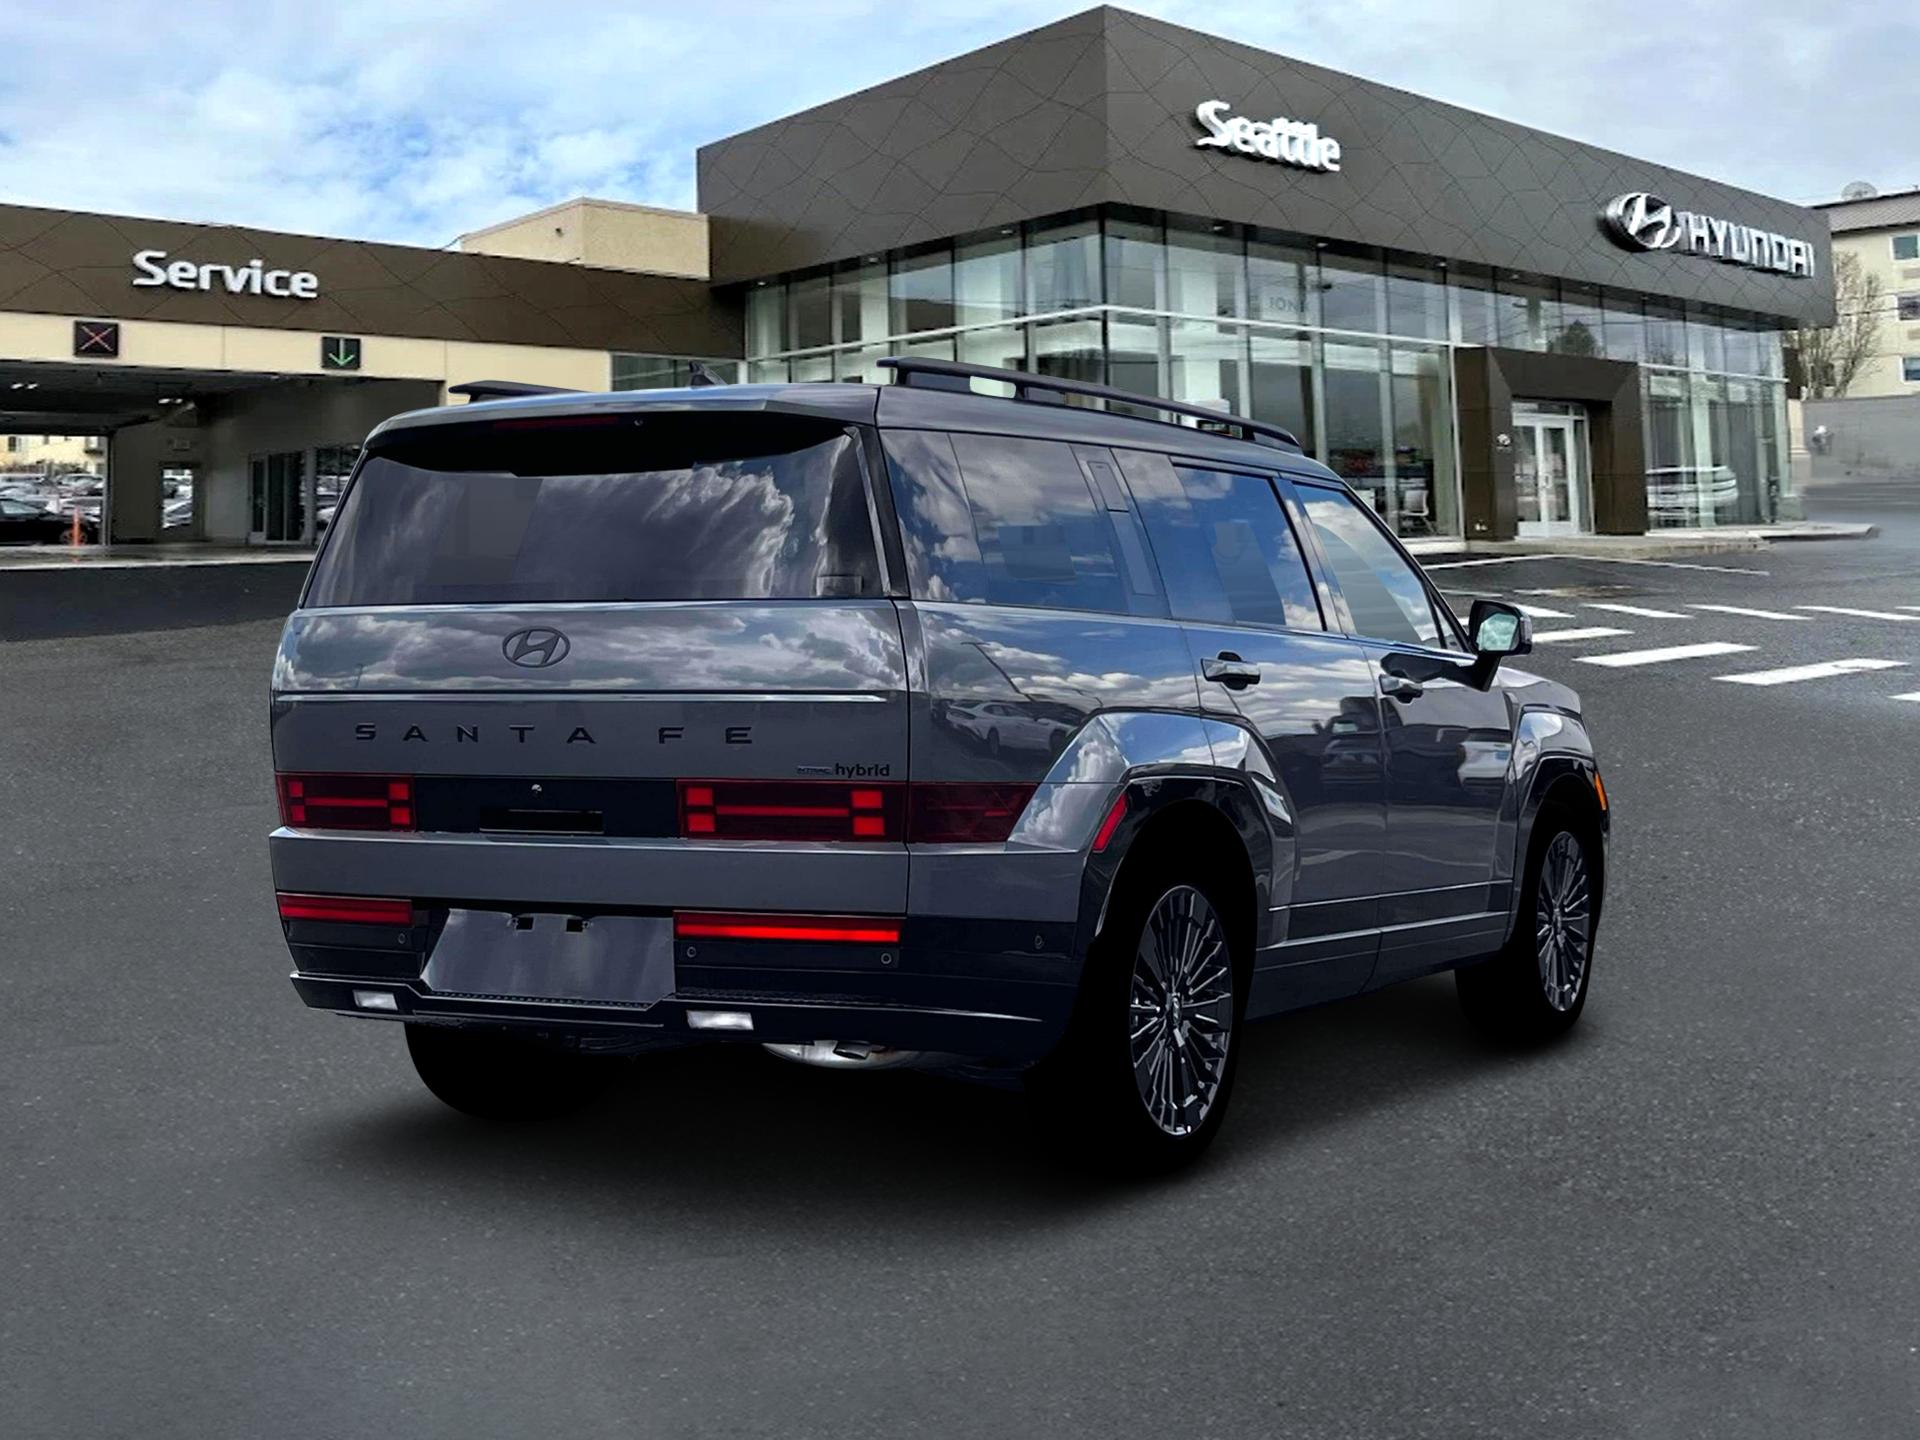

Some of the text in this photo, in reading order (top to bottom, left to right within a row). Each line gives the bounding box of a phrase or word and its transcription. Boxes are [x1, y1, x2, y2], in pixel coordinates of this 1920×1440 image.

[1196, 100, 1341, 172] Seattle
[1675, 211, 1815, 277] HYUNDAI
[132, 249, 319, 299] Service
[355, 722, 753, 745] SANTA FE
[835, 762, 890, 779] hybrid
